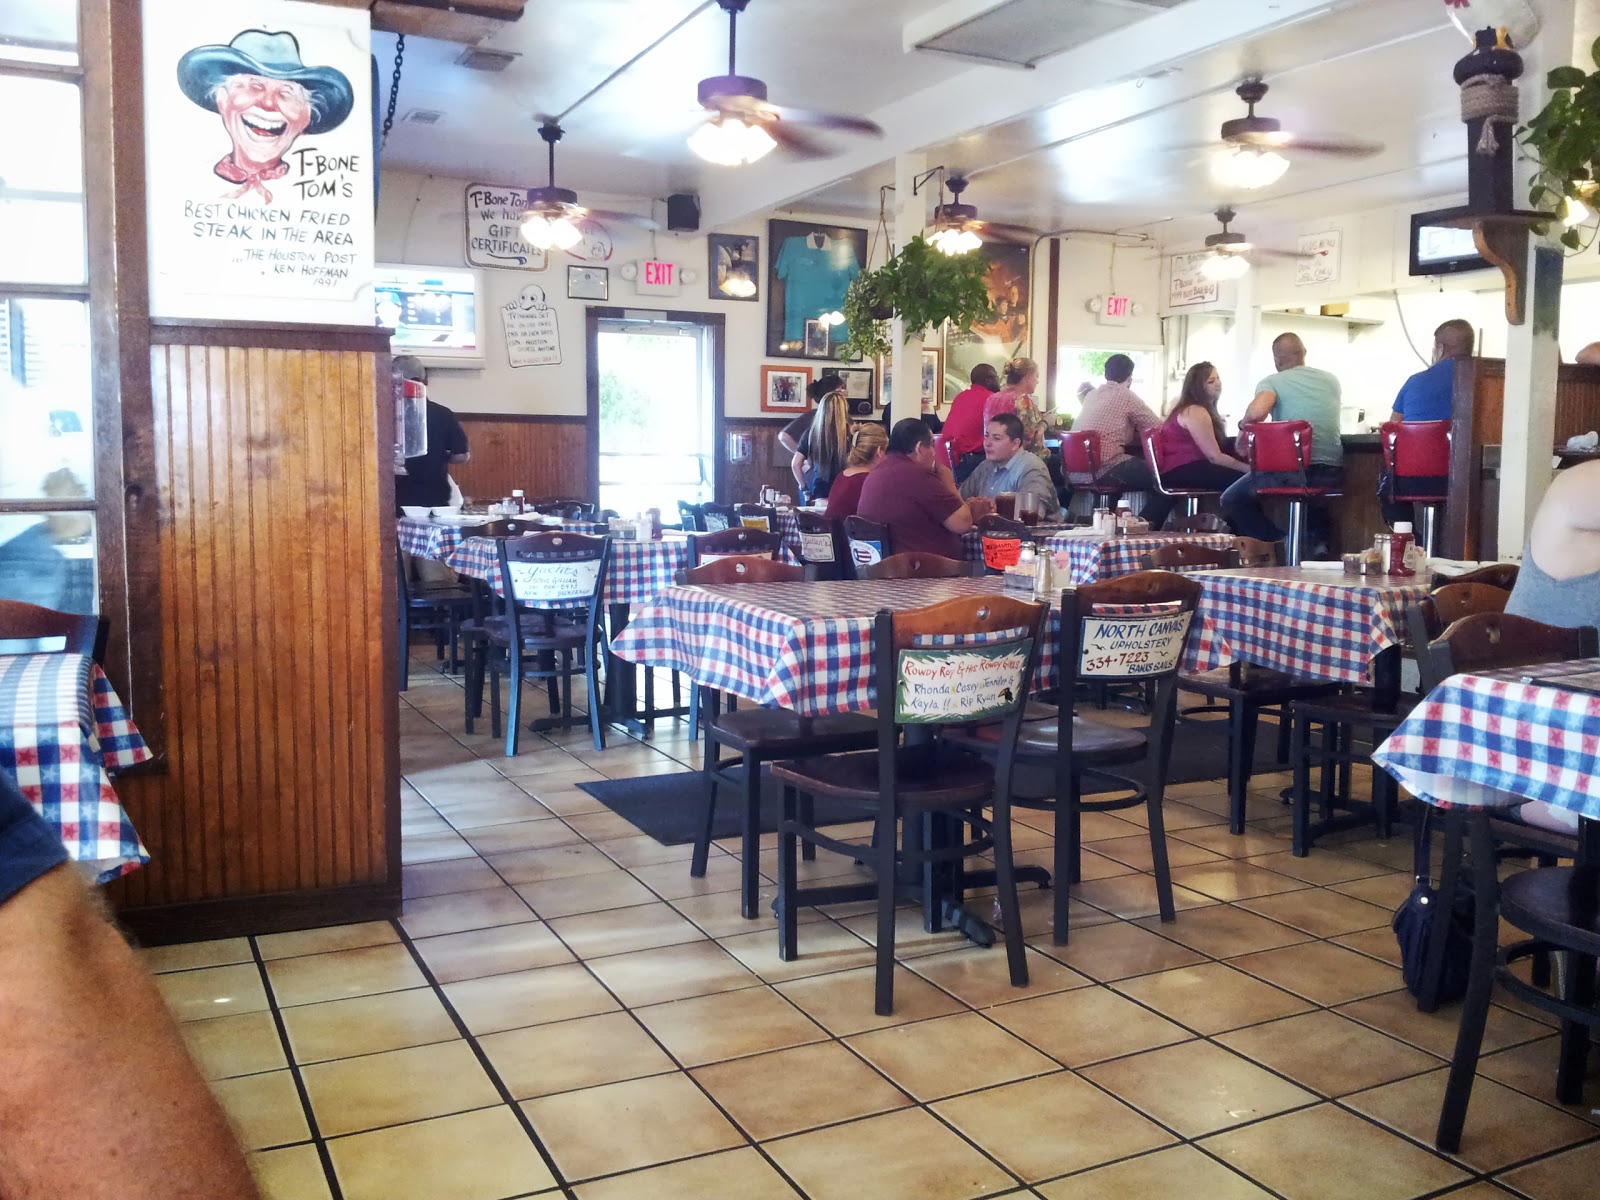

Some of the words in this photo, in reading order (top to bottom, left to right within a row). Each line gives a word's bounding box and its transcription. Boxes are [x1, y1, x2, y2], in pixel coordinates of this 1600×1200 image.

[292, 147, 360, 176] T-BONE
[292, 174, 353, 200] TOM'S
[470, 190, 508, 208] T-Bone
[184, 199, 222, 219] BEST
[227, 203, 291, 223] CHICKEN
[300, 210, 350, 226] FRIED
[481, 208, 495, 221] We
[503, 208, 524, 220] hav
[193, 221, 253, 240] STEAK
[262, 228, 277, 240] IN
[283, 227, 308, 243] THE
[313, 230, 354, 246] AREA
[489, 224, 521, 238] GIFT
[471, 237, 542, 256] CERTIFICATES
[268, 248, 316, 262] HOUSTON
[324, 251, 357, 265] POST
[274, 263, 295, 274] KEN
[301, 265, 348, 278] HOFFMAN
[646, 262, 673, 285] EXIT
[1107, 297, 1128, 316] EXIT
[1094, 623, 1146, 640] NORTH
[1149, 618, 1185, 637] CANVAS
[1110, 636, 1173, 650] UPHOLSTERY
[914, 683, 950, 695] Rhonda
[956, 682, 978, 694] Casey
[911, 697, 939, 712] Kayla
[961, 697, 973, 708] Rip
[976, 693, 996, 705] Ryan
